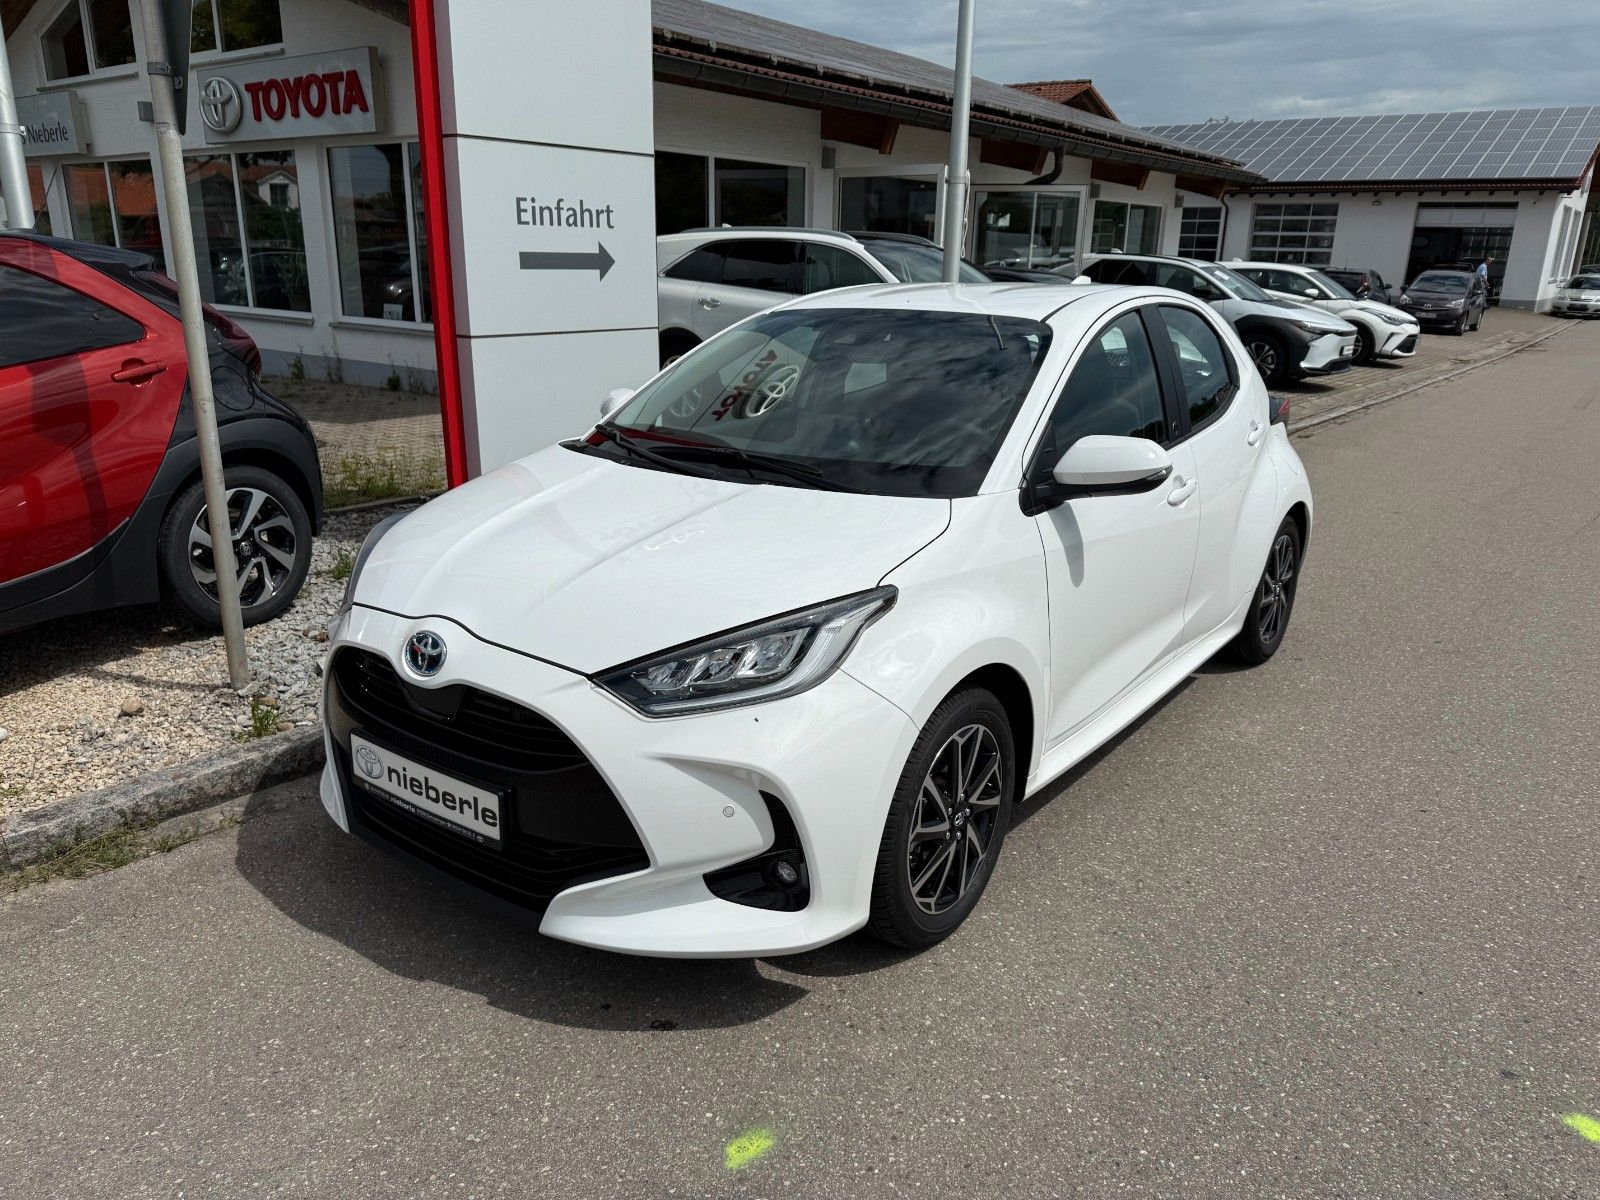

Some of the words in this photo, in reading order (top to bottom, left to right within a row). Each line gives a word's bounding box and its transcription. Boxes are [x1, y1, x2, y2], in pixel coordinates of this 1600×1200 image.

[244, 69, 369, 122] TOYOTA
[27, 120, 69, 144] Nieberle
[515, 196, 615, 229] Einfahrt
[387, 766, 498, 828] nieberle
